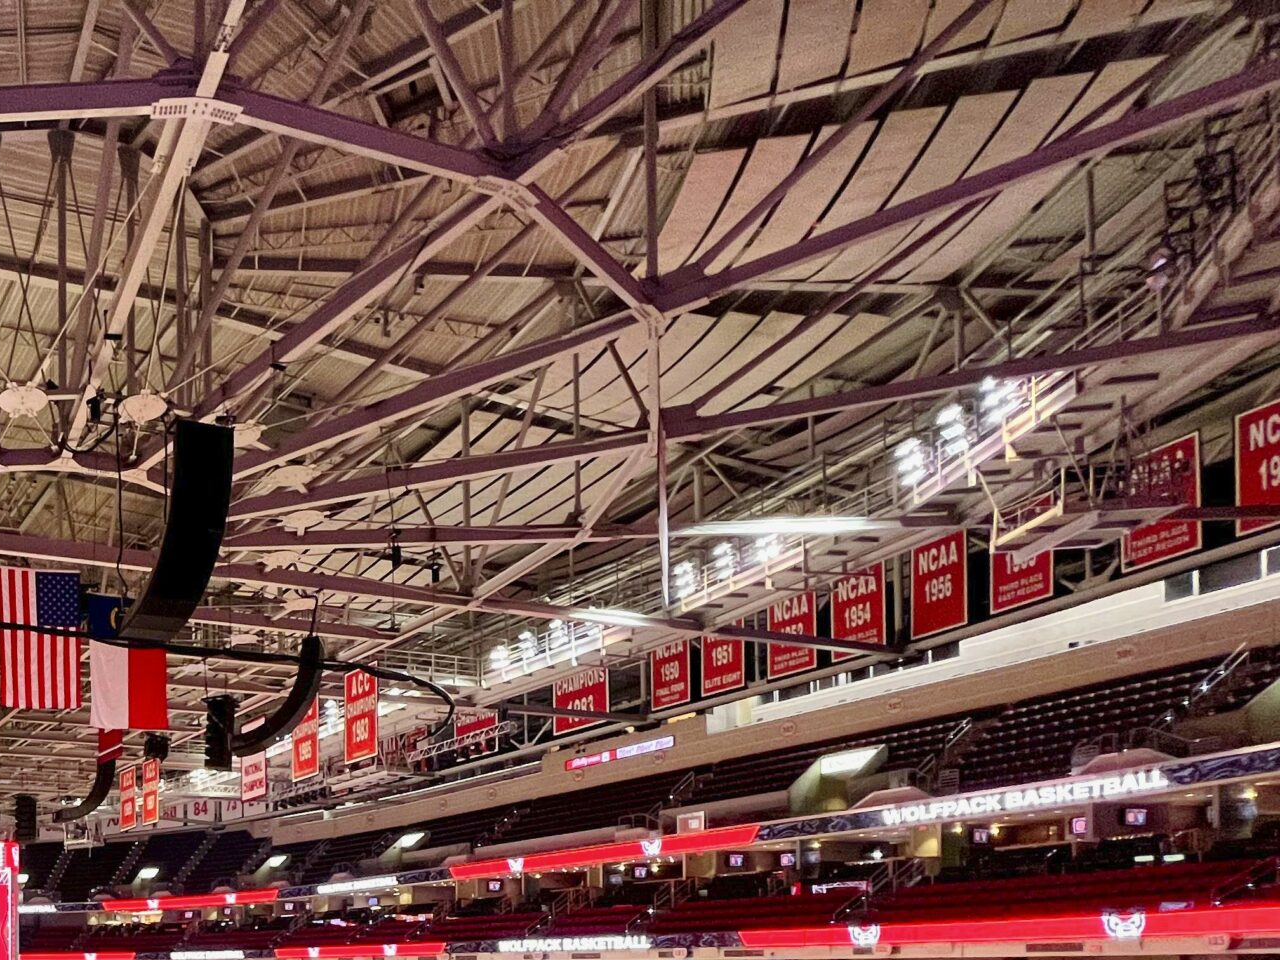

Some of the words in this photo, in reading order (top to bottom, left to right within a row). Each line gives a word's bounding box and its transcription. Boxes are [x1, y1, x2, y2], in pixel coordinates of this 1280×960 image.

[919, 541, 958, 575] NCAA
[838, 574, 877, 603] NCAA
[925, 574, 952, 604] 1956
[773, 595, 809, 623] NCAA
[844, 601, 871, 629] 1954
[712, 643, 732, 667] 1951
[351, 672, 370, 697] ACC
[556, 669, 605, 696] CHAMPIONS
[661, 661, 680, 682] 1950
[193, 801, 208, 816] 84
[881, 794, 1002, 825] WOLFPACK
[1003, 769, 1169, 810] BASKETBALL
[498, 938, 561, 952] WOLFPACK
[562, 935, 652, 951] BASKETBALL
